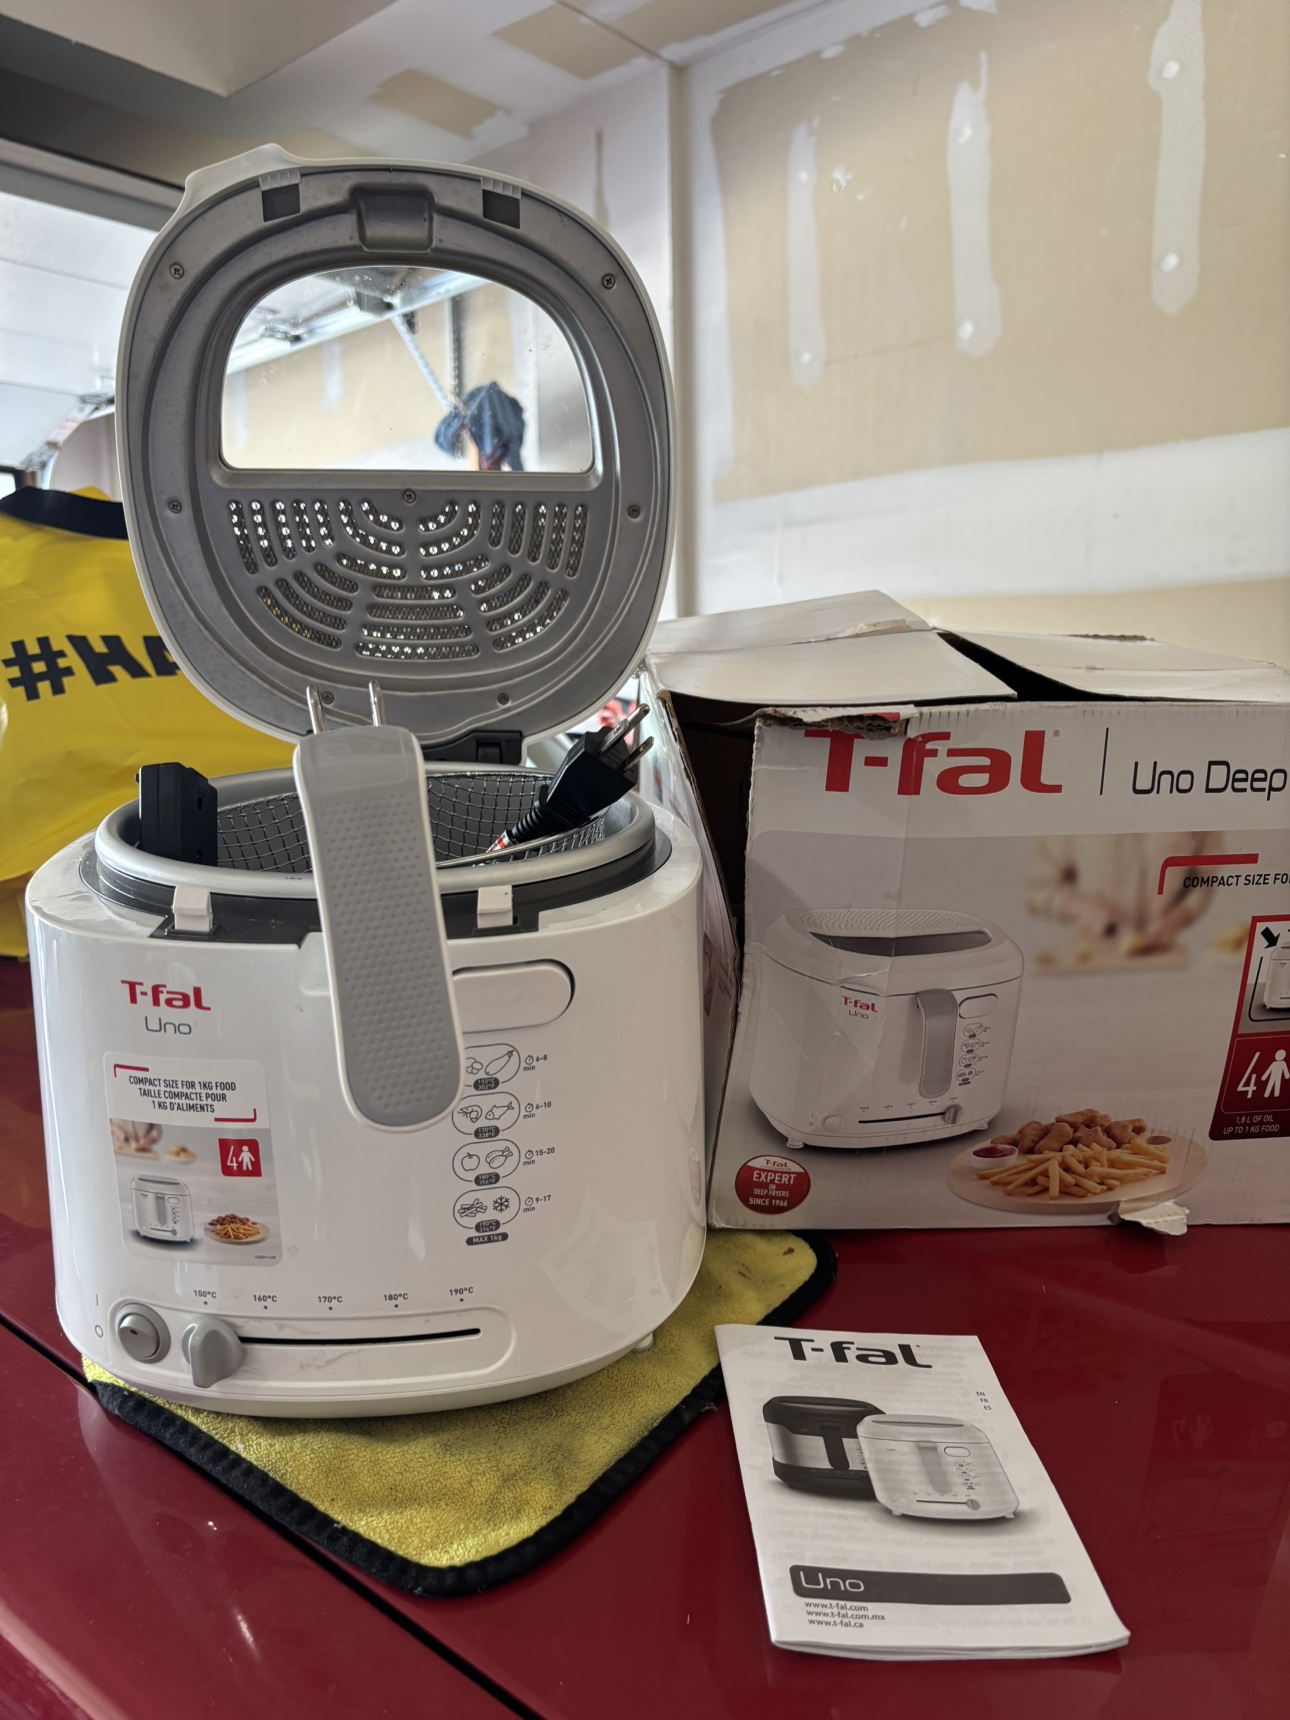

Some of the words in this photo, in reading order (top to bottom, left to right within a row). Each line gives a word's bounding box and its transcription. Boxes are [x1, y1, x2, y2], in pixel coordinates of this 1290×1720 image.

[804, 729, 1062, 796] T-fal
[1132, 761, 1195, 795] Uno
[1205, 760, 1288, 801] Deep
[1183, 875, 1241, 889] COMPACT
[1244, 873, 1271, 886] SIZE
[1273, 872, 1290, 885] FO
[121, 980, 211, 1011] T-fal
[842, 996, 878, 1013] T-fal
[848, 1009, 869, 1020] Uno
[144, 1016, 192, 1035] Uno
[535, 1054, 548, 1062] 6-8
[1237, 1051, 1260, 1099] 4
[128, 1075, 162, 1088] COMPACT
[163, 1079, 179, 1089] SIZE
[181, 1080, 197, 1091] FOR
[215, 1081, 237, 1092] FOOD
[138, 1087, 162, 1099] TAILLE
[163, 1090, 204, 1102] COMPACTE
[205, 1093, 228, 1103] POUR
[152, 1100, 156, 1110] 1
[157, 1101, 168, 1111] KG
[169, 1102, 215, 1113] D'ALIMENTS
[535, 1101, 552, 1110] 6-10
[1252, 1115, 1262, 1123] OF
[1263, 1114, 1274, 1122] OIL
[1223, 1127, 1234, 1135] UP
[1235, 1126, 1244, 1134] TO
[1250, 1125, 1260, 1133] KG
[1261, 1124, 1280, 1132] FOOD
[535, 1147, 555, 1156] 15-20
[226, 1145, 238, 1170] 4
[753, 1170, 797, 1185] EXPERT
[535, 1194, 552, 1203] 9-17
[753, 1188, 768, 1196] DEEP
[768, 1189, 790, 1198] FRYERS
[748, 1197, 770, 1206] SINCE
[771, 1199, 788, 1207] 1966
[472, 1235, 489, 1244] MAX
[193, 1289, 217, 1299] 150°C
[449, 1286, 474, 1296] 190°C
[252, 1294, 278, 1303] 160°C
[317, 1295, 343, 1304] 170°C
[383, 1292, 409, 1302] 180°C
[774, 1336, 933, 1369] T-fal
[800, 1570, 865, 1592] Uno
[804, 1601, 869, 1612] www.t-fal.com
[806, 1609, 886, 1621] www.t-fal.com.mx
[808, 1618, 864, 1629] www.t-fal.ca
